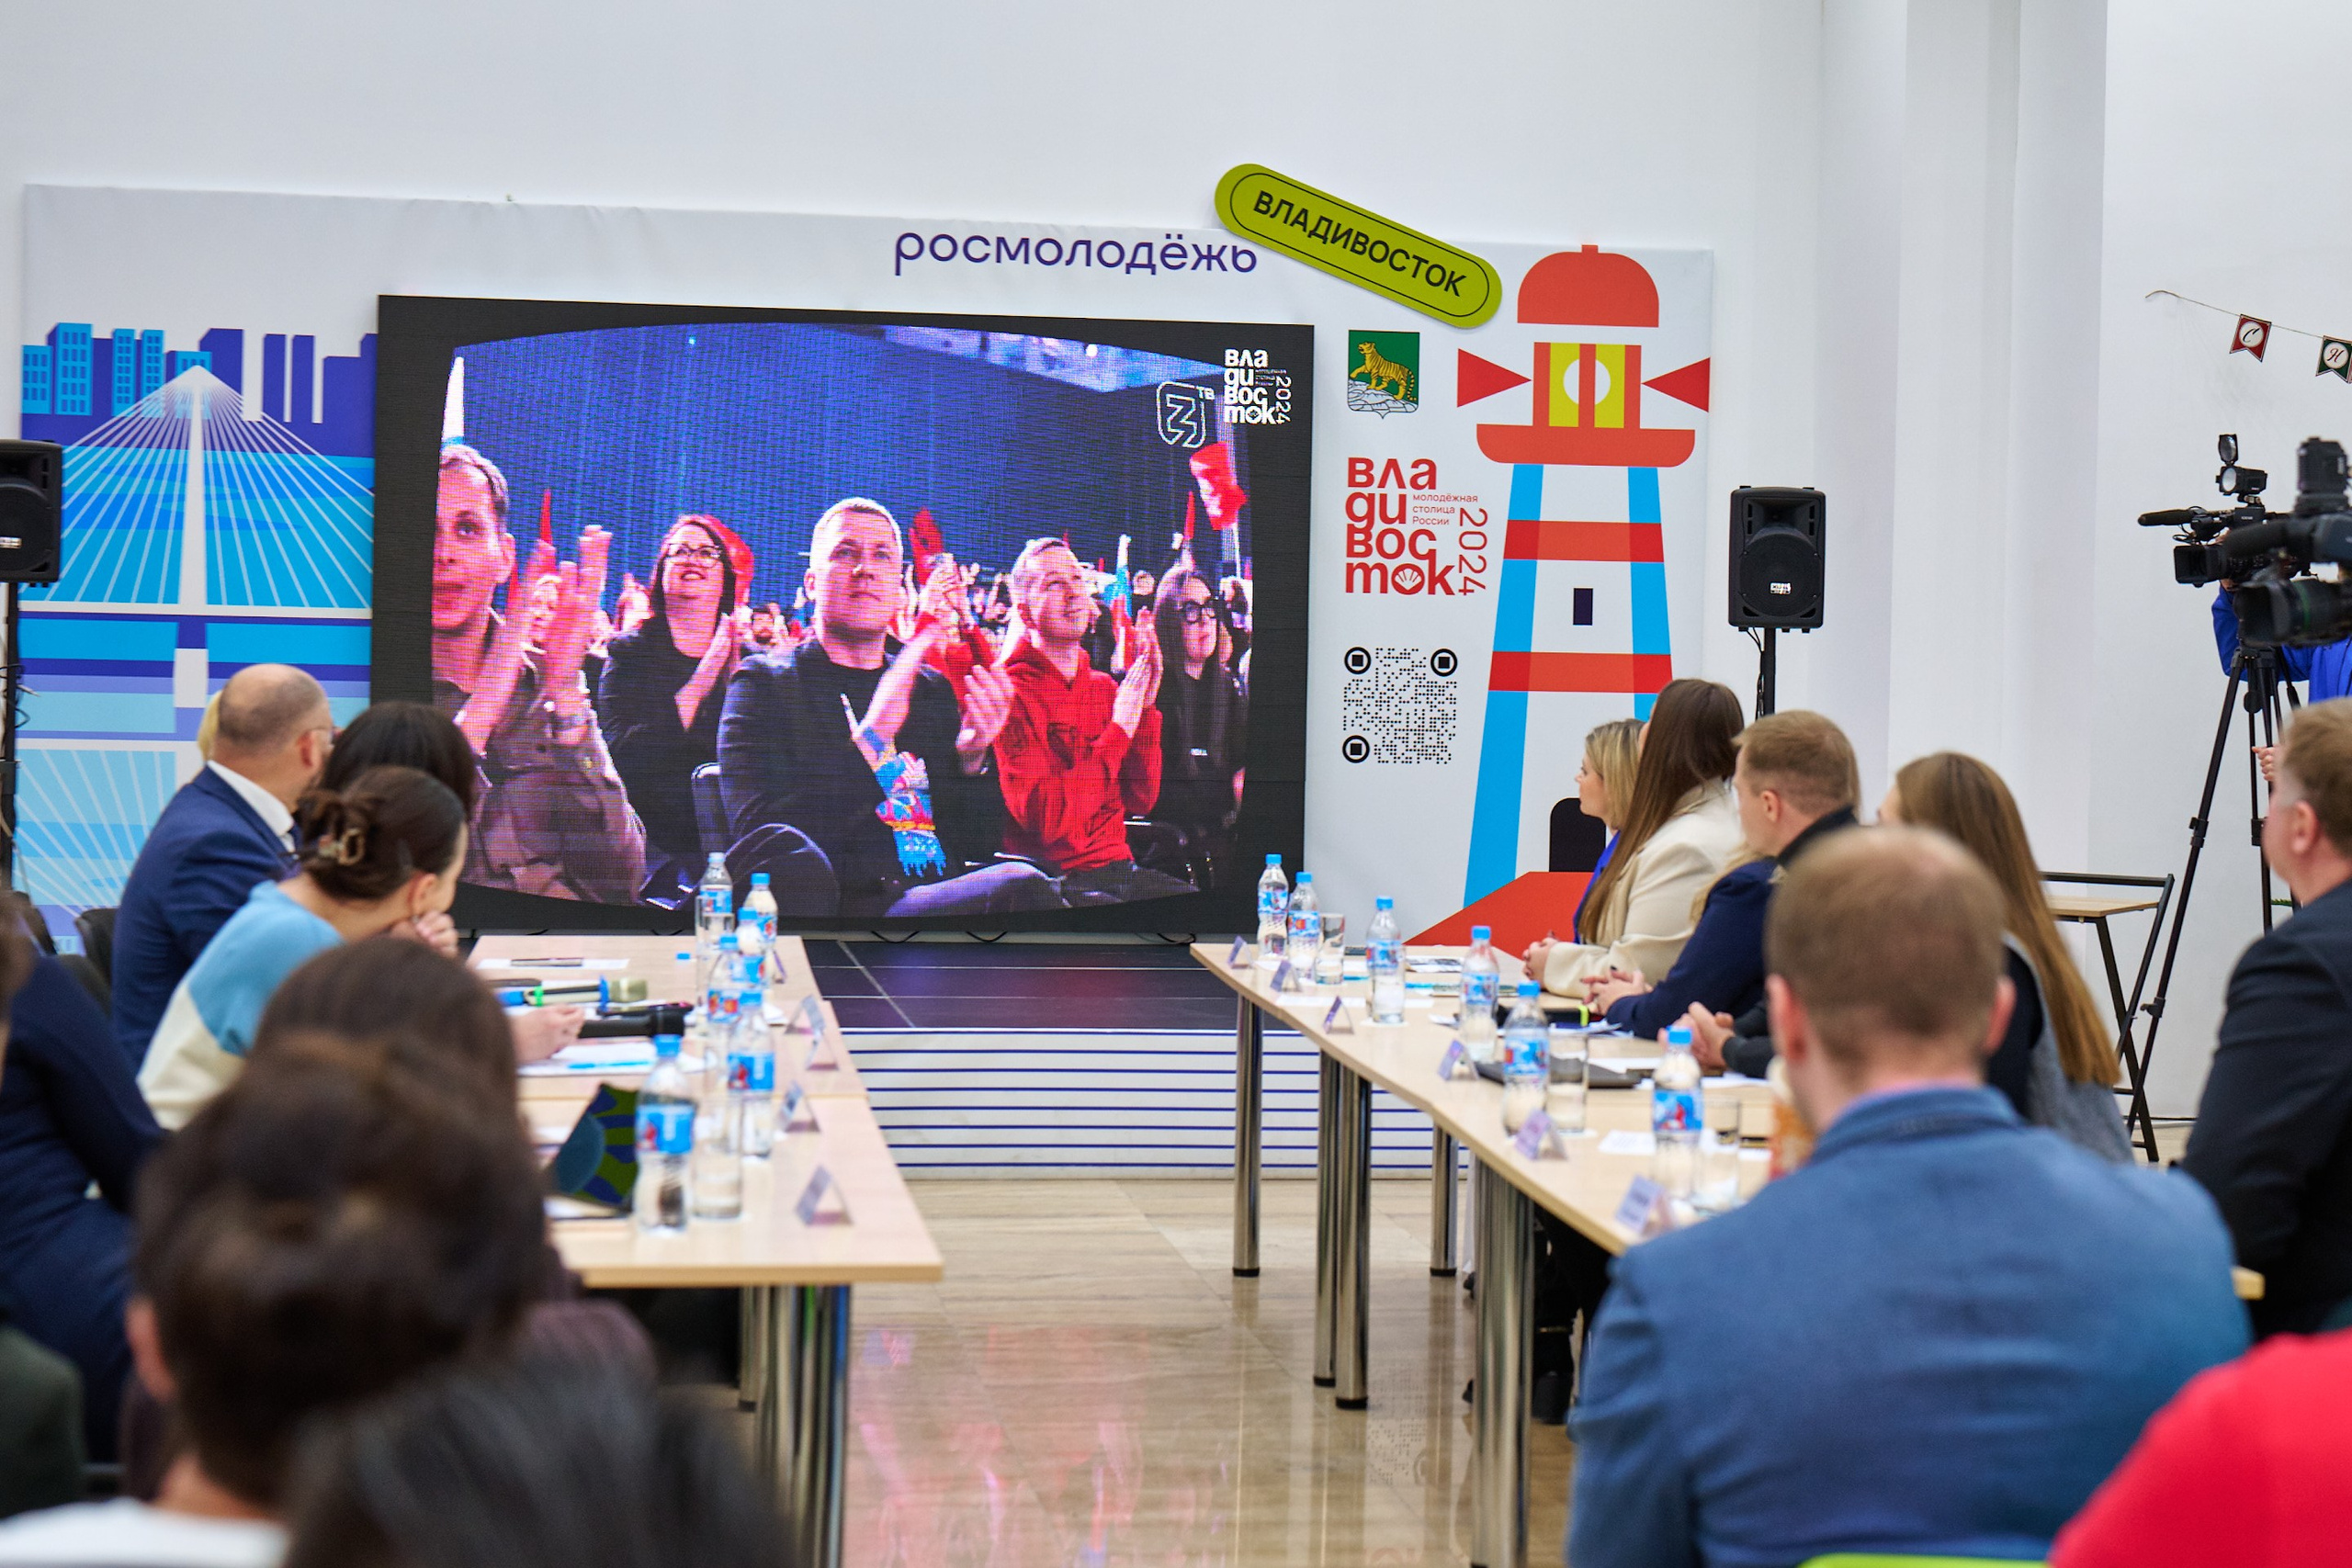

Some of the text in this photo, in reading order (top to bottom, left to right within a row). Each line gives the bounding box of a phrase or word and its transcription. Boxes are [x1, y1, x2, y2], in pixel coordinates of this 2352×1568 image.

[894, 231, 1258, 276] росмолодёжь
[1253, 190, 1467, 298] ВЛАДИВОСТОК
[1275, 376, 1292, 424] 2024
[1347, 457, 1438, 491] вла
[1412, 493, 1479, 502] молодёжная
[1412, 505, 1456, 514] столица
[1412, 515, 1450, 525] России
[1458, 507, 1488, 596] 2024
